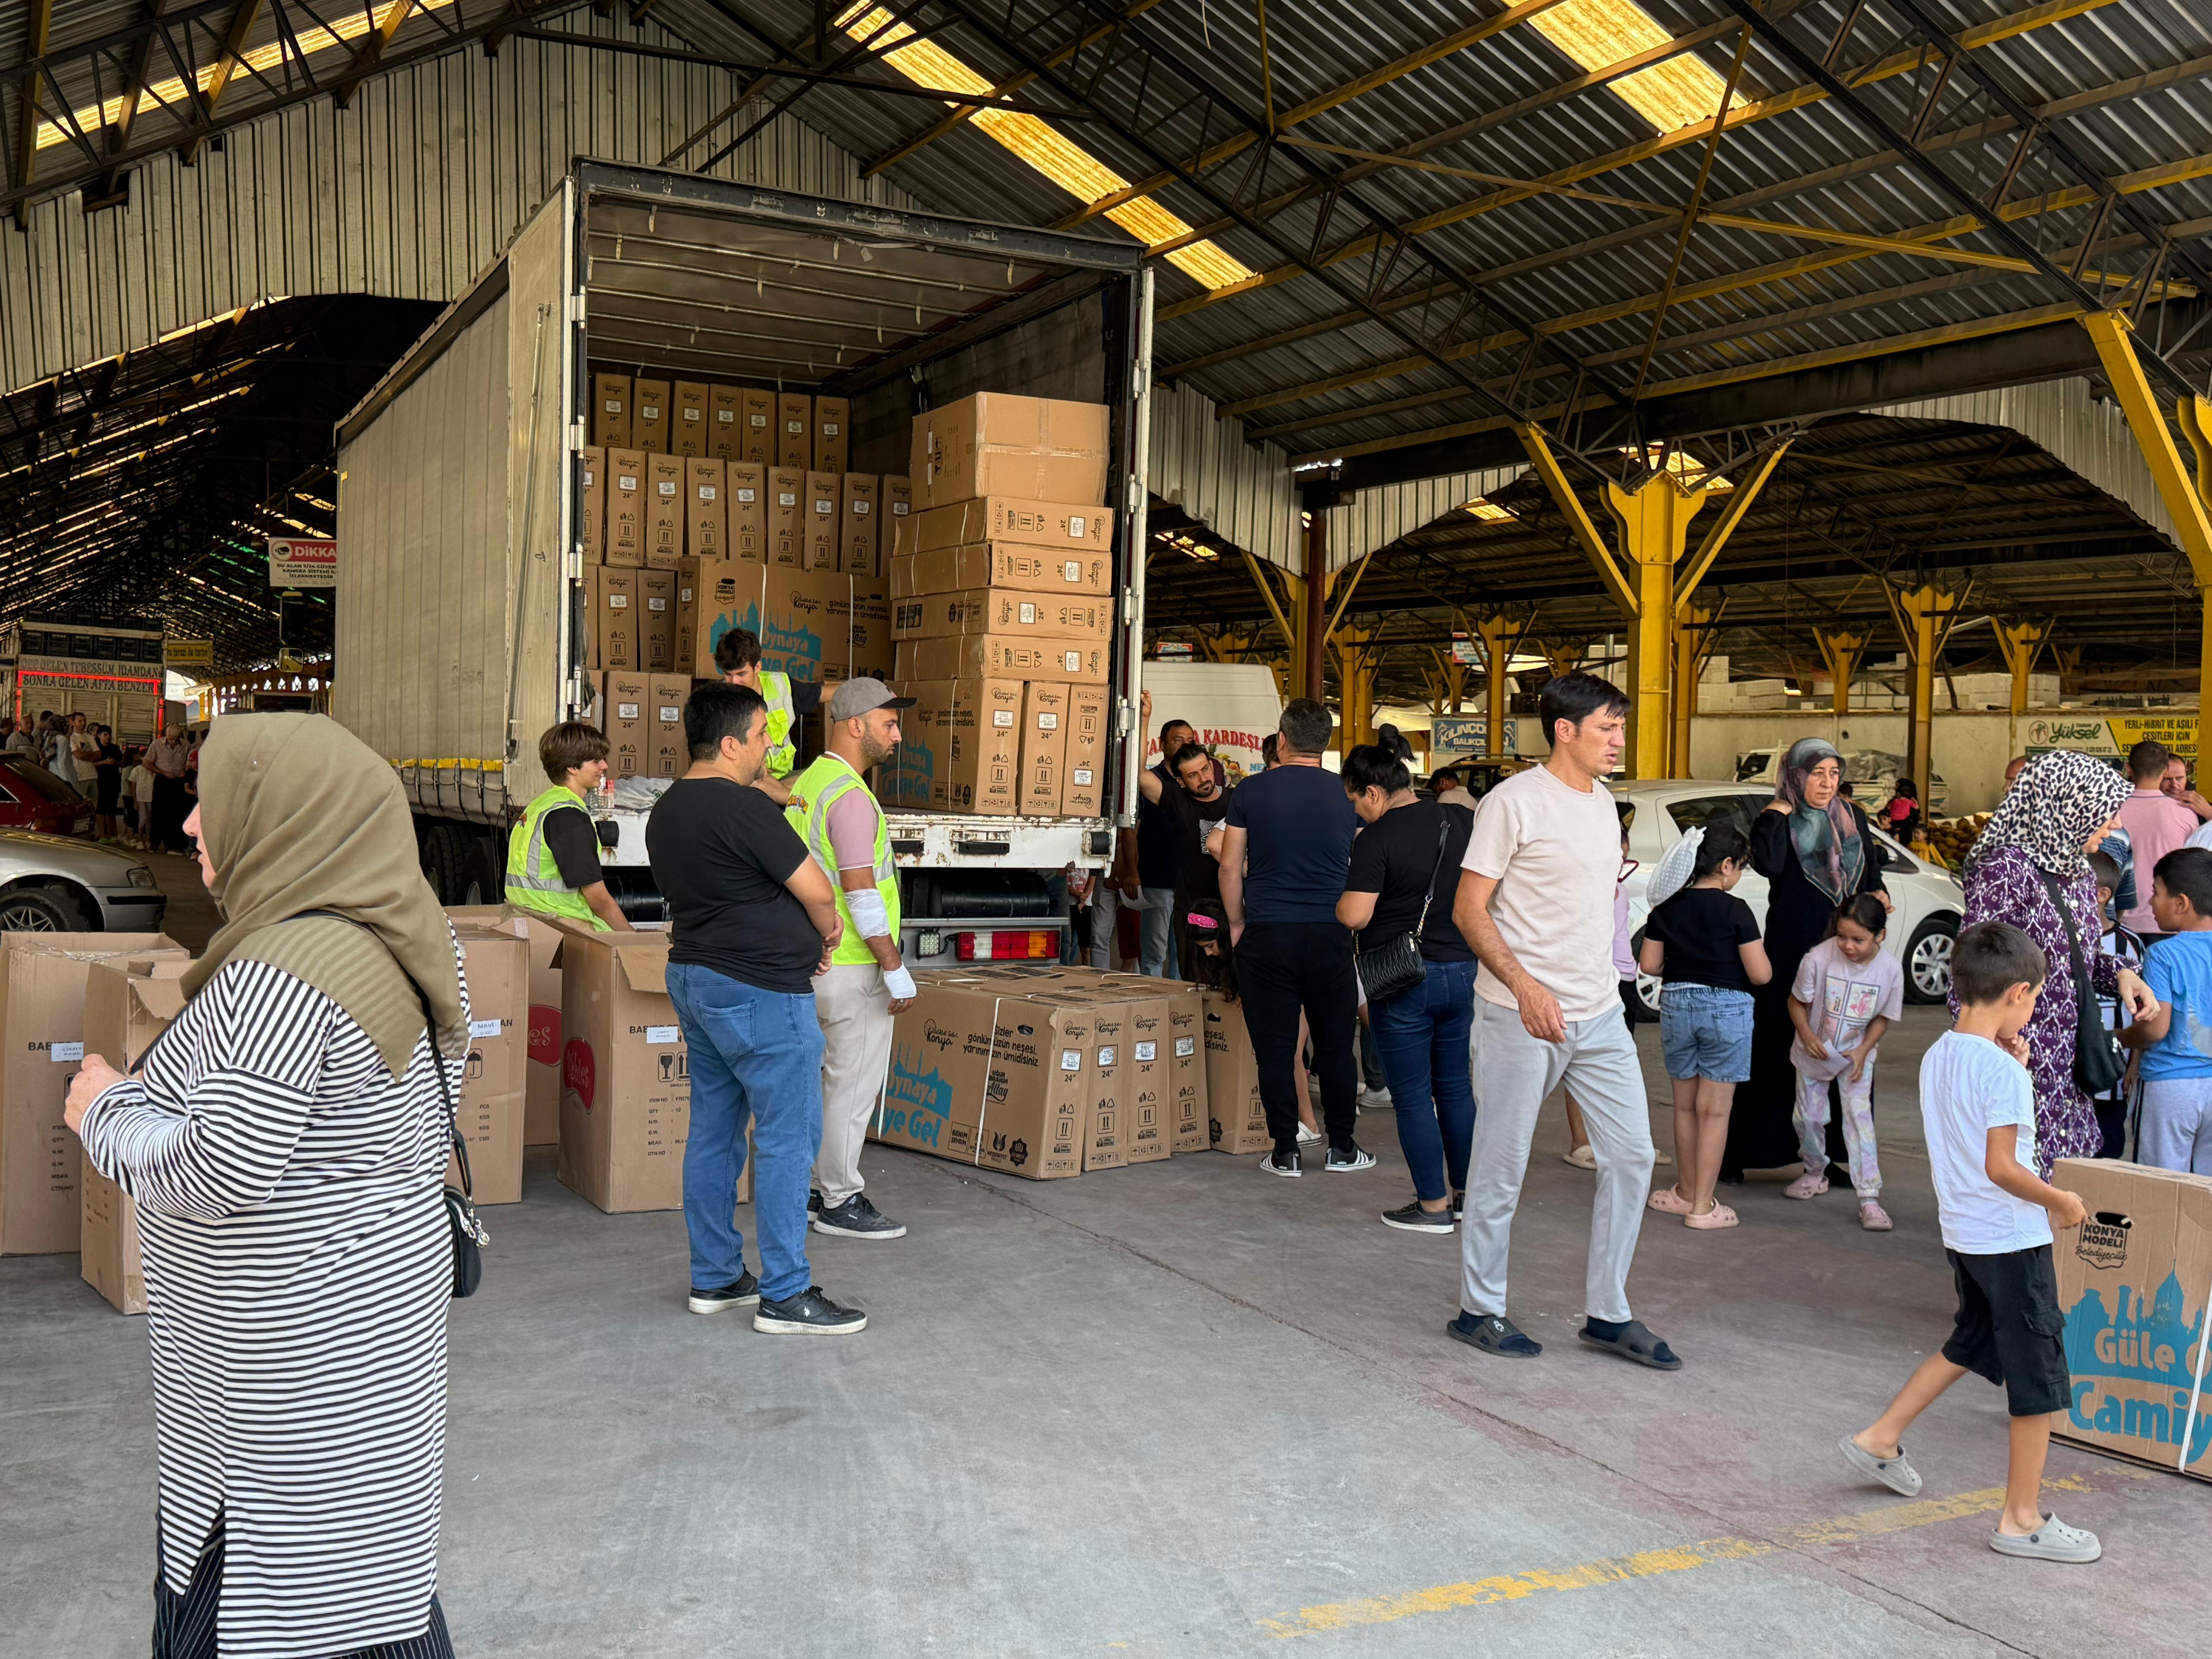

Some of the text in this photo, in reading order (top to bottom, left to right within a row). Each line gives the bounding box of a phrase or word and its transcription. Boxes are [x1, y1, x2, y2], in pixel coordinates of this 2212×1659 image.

[295, 546, 337, 557] DİKKA
[794, 597, 817, 614] Konya
[785, 656, 815, 681] Gel
[23, 675, 56, 686] SONRA
[59, 675, 88, 690] GELEN
[619, 685, 639, 696] Konya
[659, 688, 680, 699] Konya
[994, 691, 1014, 703] Konya
[1039, 693, 1059, 705] Konya
[2167, 719, 2175, 729] VE
[2049, 722, 2101, 744] Yüksel
[2176, 731, 2190, 741] İÇİN
[1203, 729, 1264, 753] KARDEŞL
[1453, 738, 1487, 747] BALIKÇIL
[2175, 744, 2198, 753] ADRES
[1136, 1020, 1157, 1031] Konya
[1173, 1016, 1192, 1027] Konya
[994, 1025, 1014, 1038] Sizler
[1065, 1027, 1084, 1040] Konya
[1099, 1024, 1119, 1036] Konya
[1205, 1030, 1226, 1042] eşesi,
[927, 1028, 953, 1052] Konya
[1205, 1040, 1230, 1052] disiniz.
[1012, 1042, 1037, 1055] neşesi,
[963, 1045, 1039, 1067] yarınımzın ümidisiniz.
[1180, 1059, 1191, 1068] 24"
[908, 1110, 942, 1148] Gel
[952, 1130, 968, 1139] BENİM
[2084, 1224, 2124, 1239] KONYA
[2094, 1328, 2176, 1373] Güle
